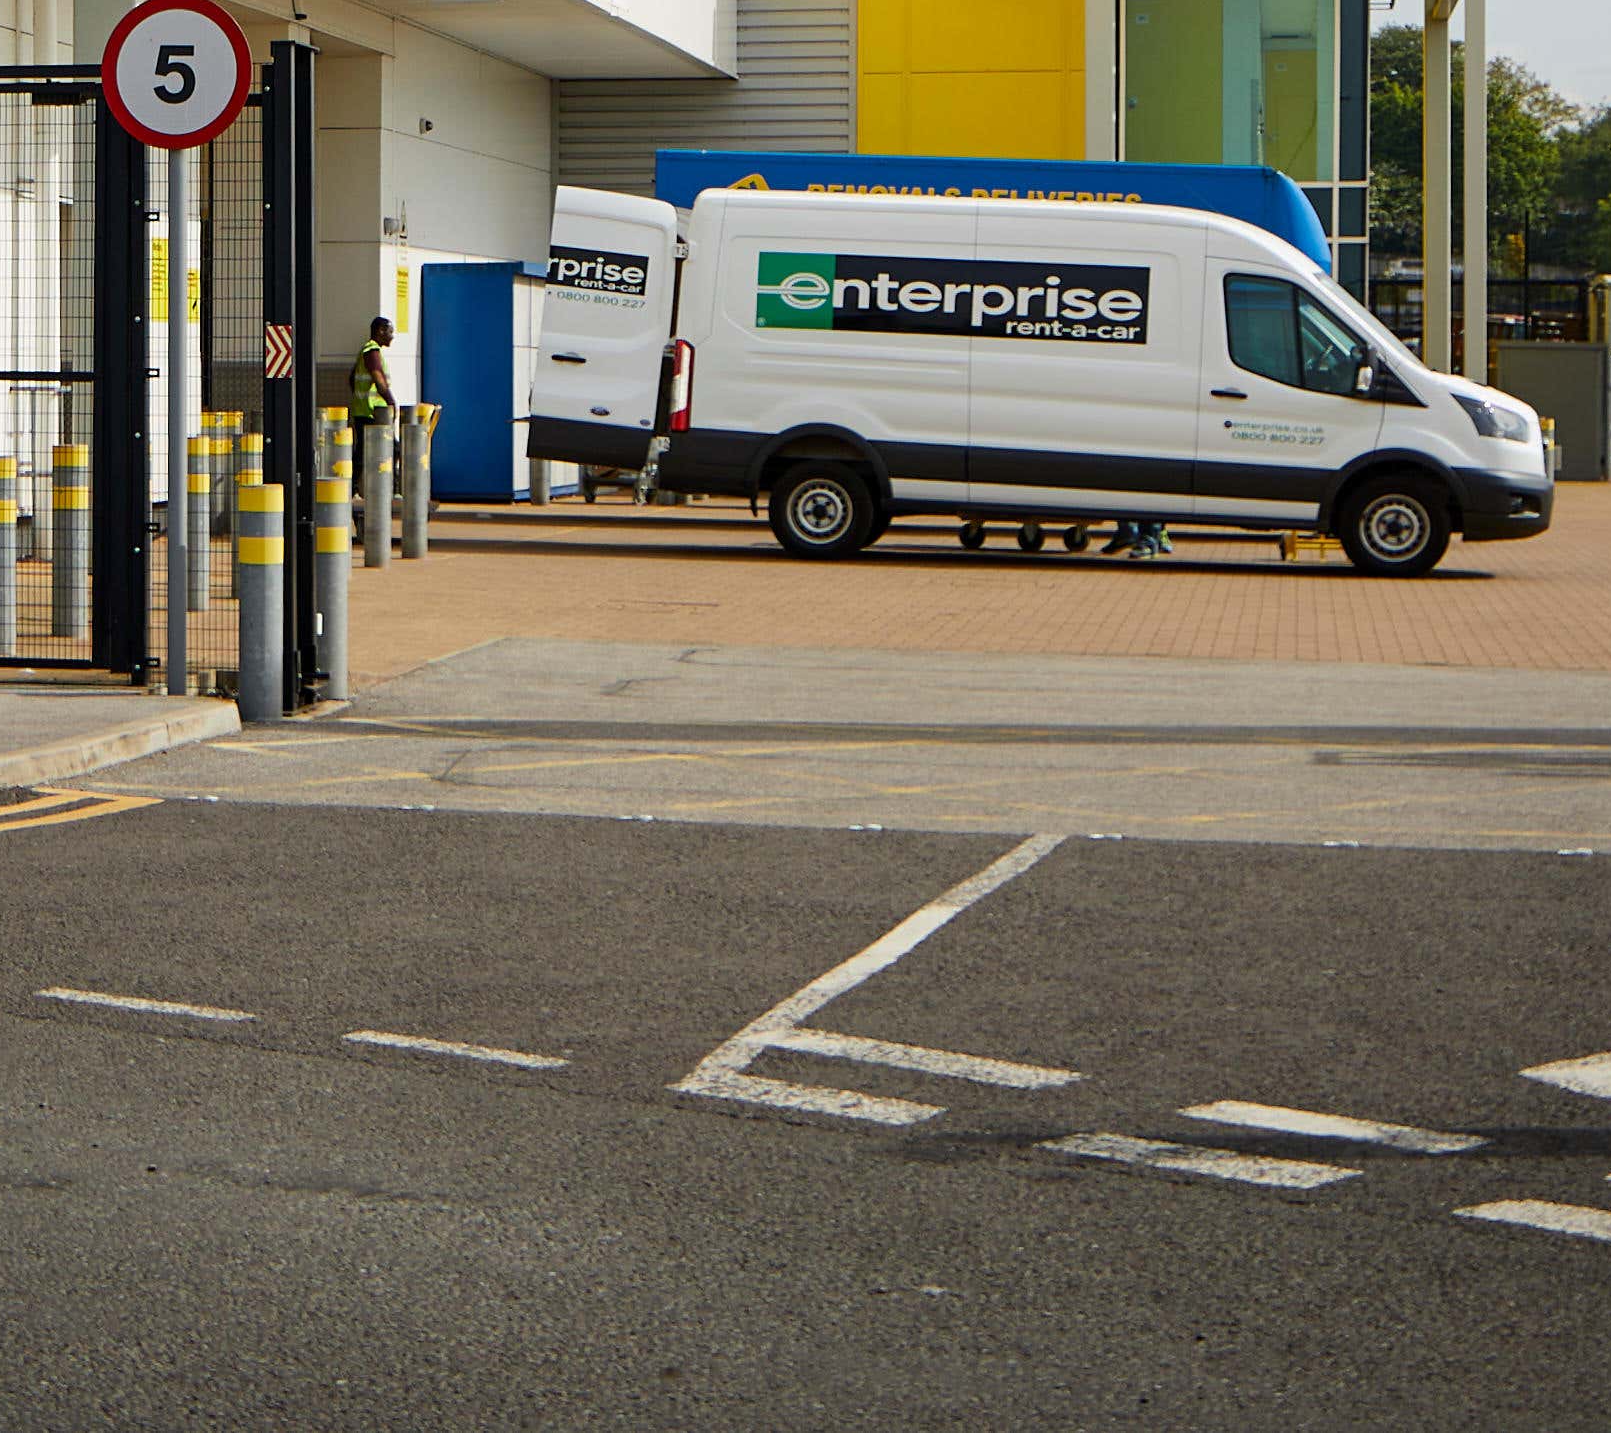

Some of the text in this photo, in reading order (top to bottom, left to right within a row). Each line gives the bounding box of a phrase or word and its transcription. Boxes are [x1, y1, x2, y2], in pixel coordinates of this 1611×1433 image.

[153, 44, 197, 105] 5
[574, 278, 643, 294] rent-a-car
[557, 291, 645, 309] 0800 800 227
[779, 273, 1143, 327] enterprise
[1005, 319, 1141, 340] rent-a-car
